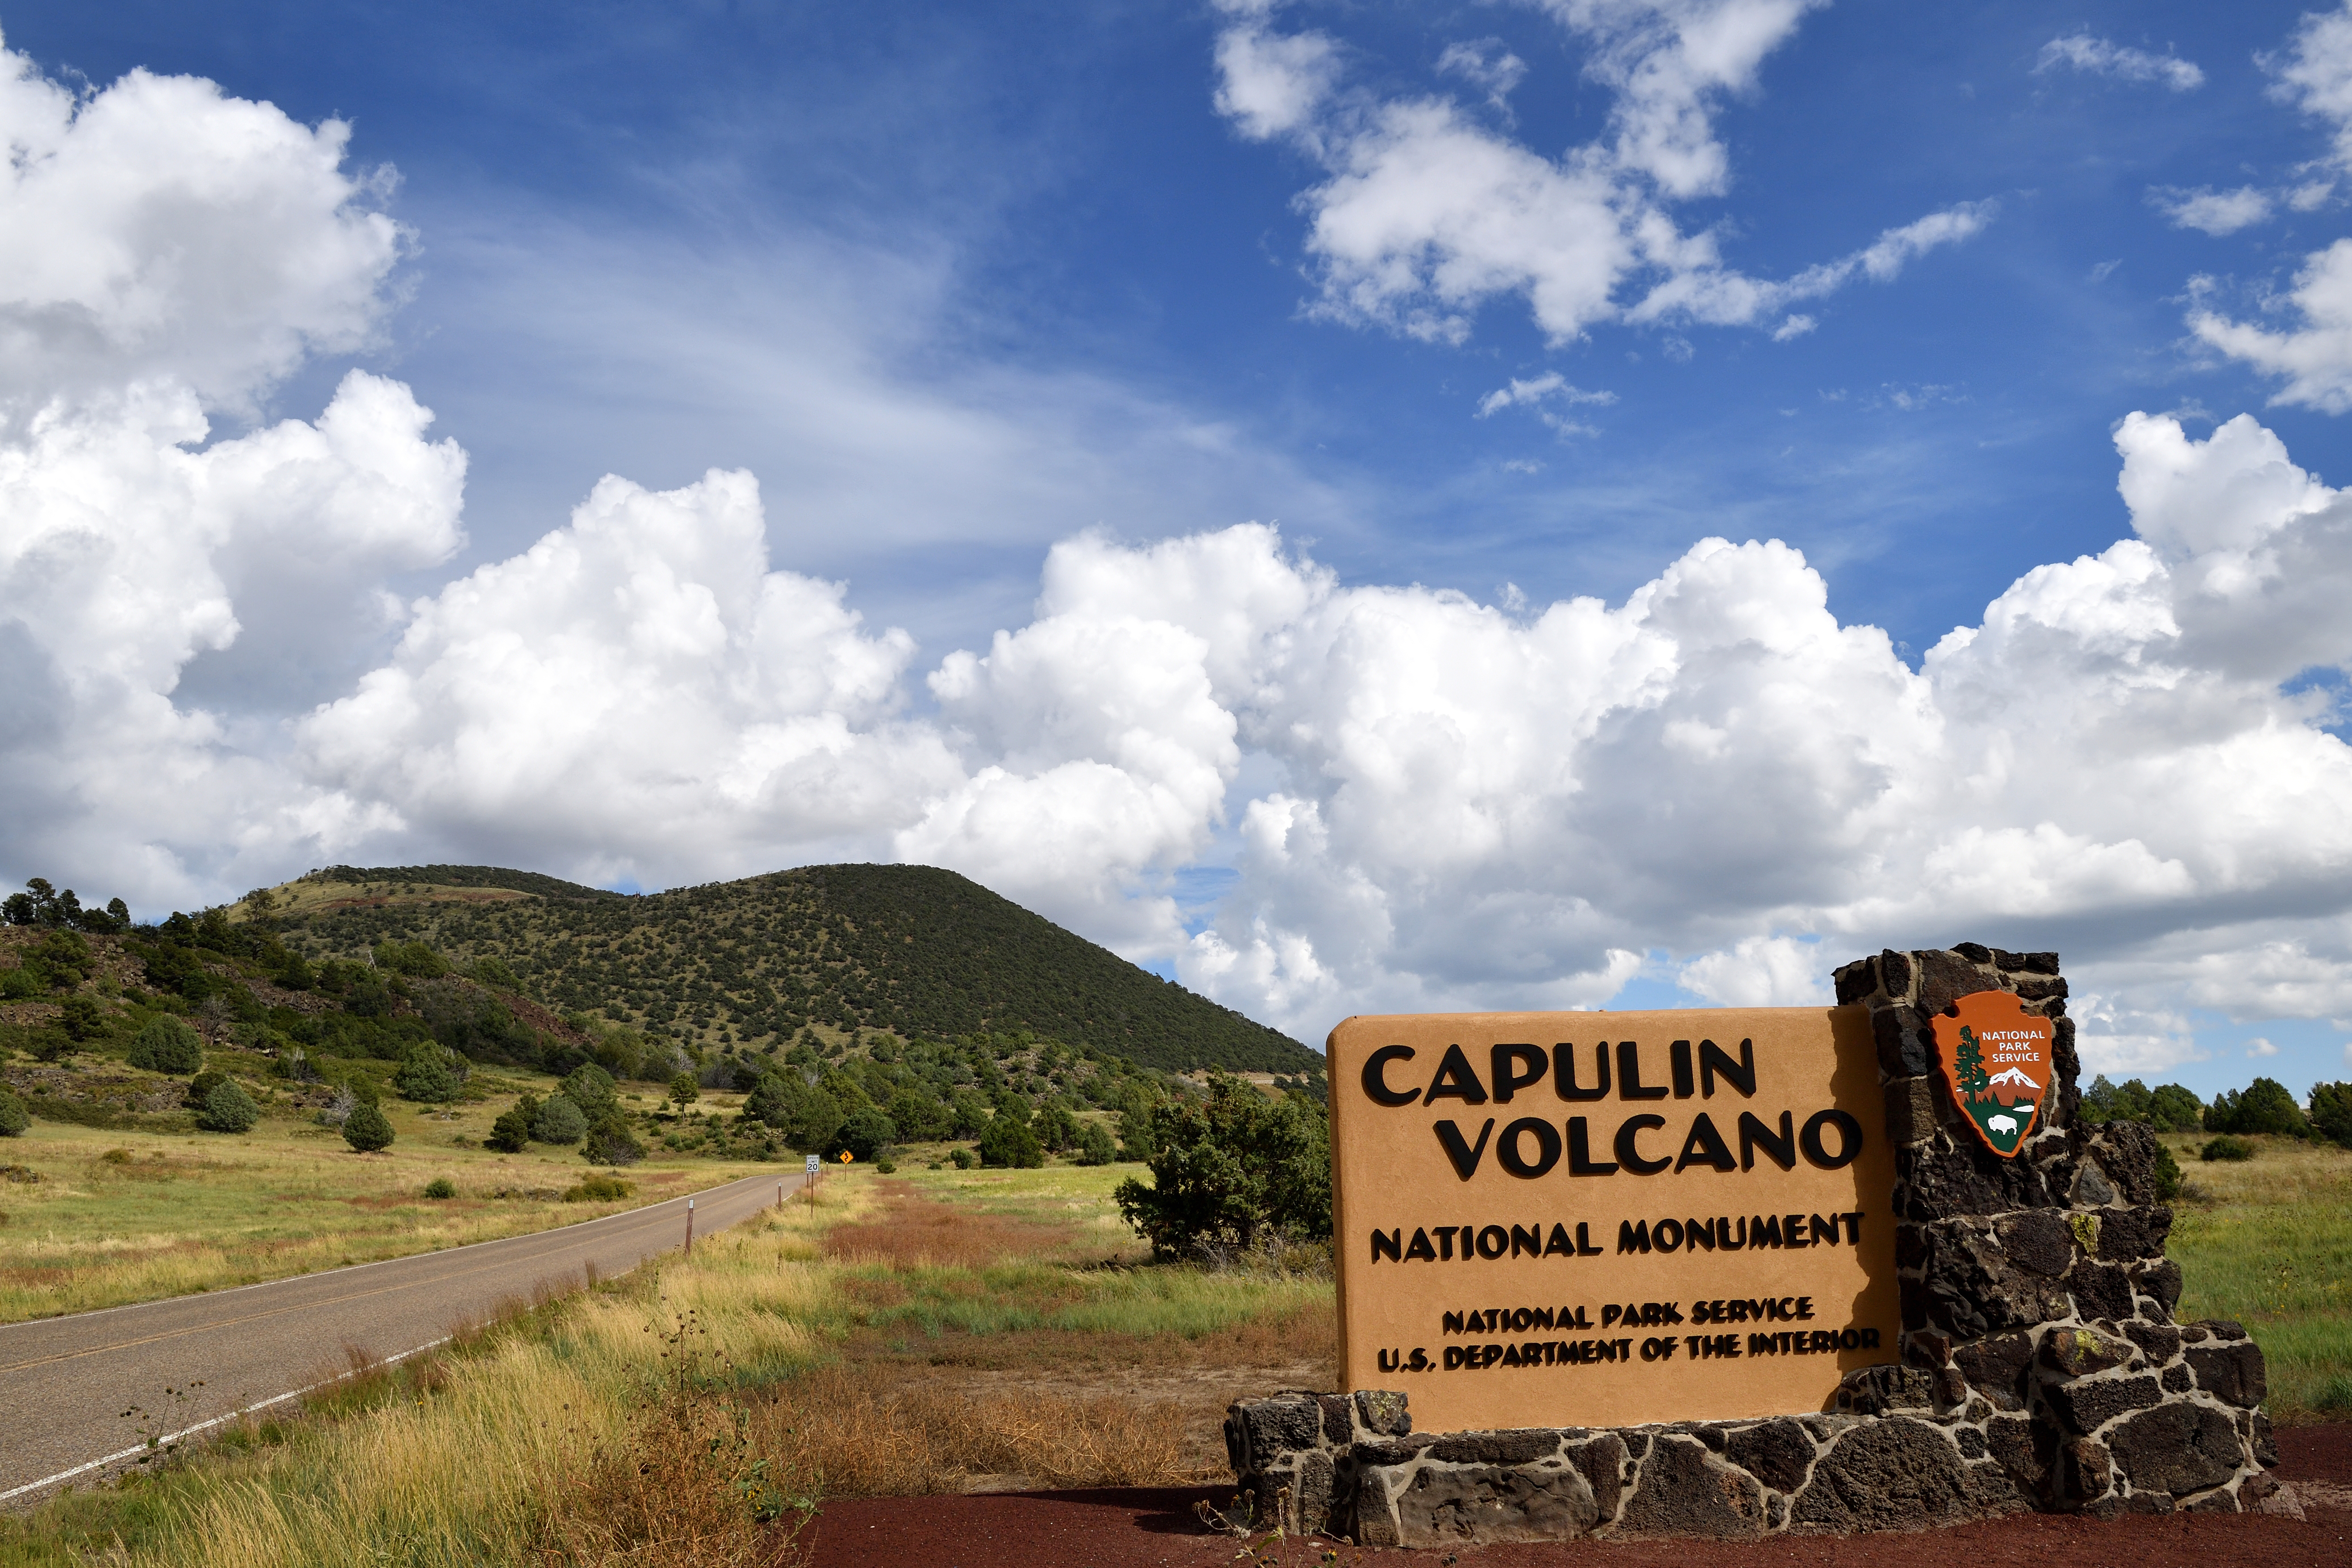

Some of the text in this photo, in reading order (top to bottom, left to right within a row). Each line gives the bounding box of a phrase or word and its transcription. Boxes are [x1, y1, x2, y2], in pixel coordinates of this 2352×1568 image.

[1982, 1030, 2045, 1040] NATIONAL
[1999, 1042, 2031, 1051] PARK
[1362, 1039, 1756, 1106] CAPULIN
[1992, 1052, 2040, 1062] SERVICE
[1434, 1109, 1863, 1181] VOLCANO
[1371, 1212, 1864, 1263] NATIONAL MONUMENT
[1443, 1297, 1815, 1335] NATIONAL PARK SERVICE
[1378, 1327, 1880, 1373] U.S. DEPARTMENT OF THE INTERIOR
